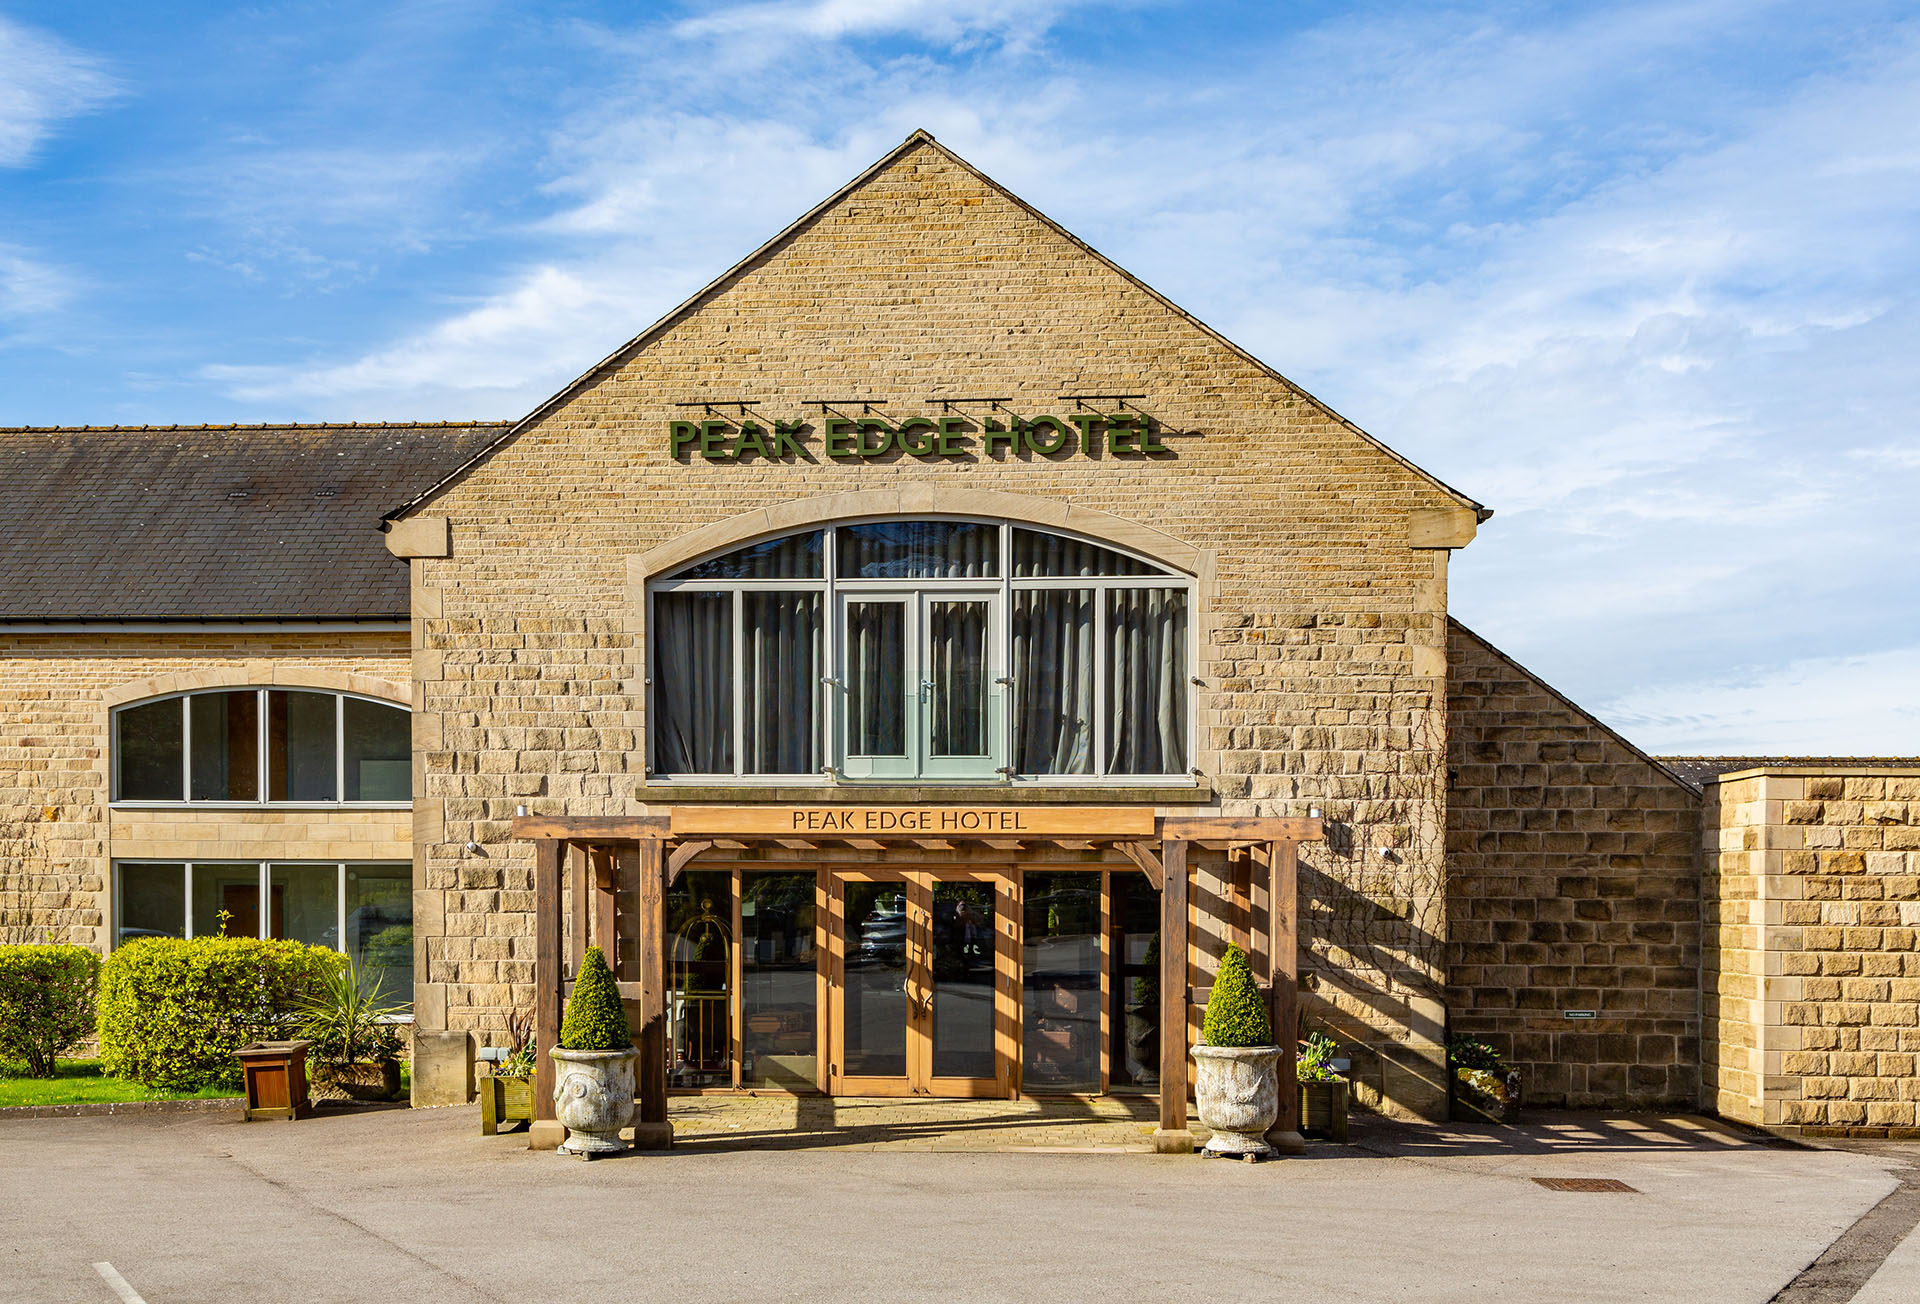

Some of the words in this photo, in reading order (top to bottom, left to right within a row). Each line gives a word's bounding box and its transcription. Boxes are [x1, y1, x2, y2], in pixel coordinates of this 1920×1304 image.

[670, 420, 806, 458] PEAK
[825, 417, 965, 457] EDGE
[984, 414, 1166, 455] HOTEL
[793, 811, 856, 830] PEAK
[865, 811, 932, 830] EDGE
[941, 811, 1028, 830] HOTEL
